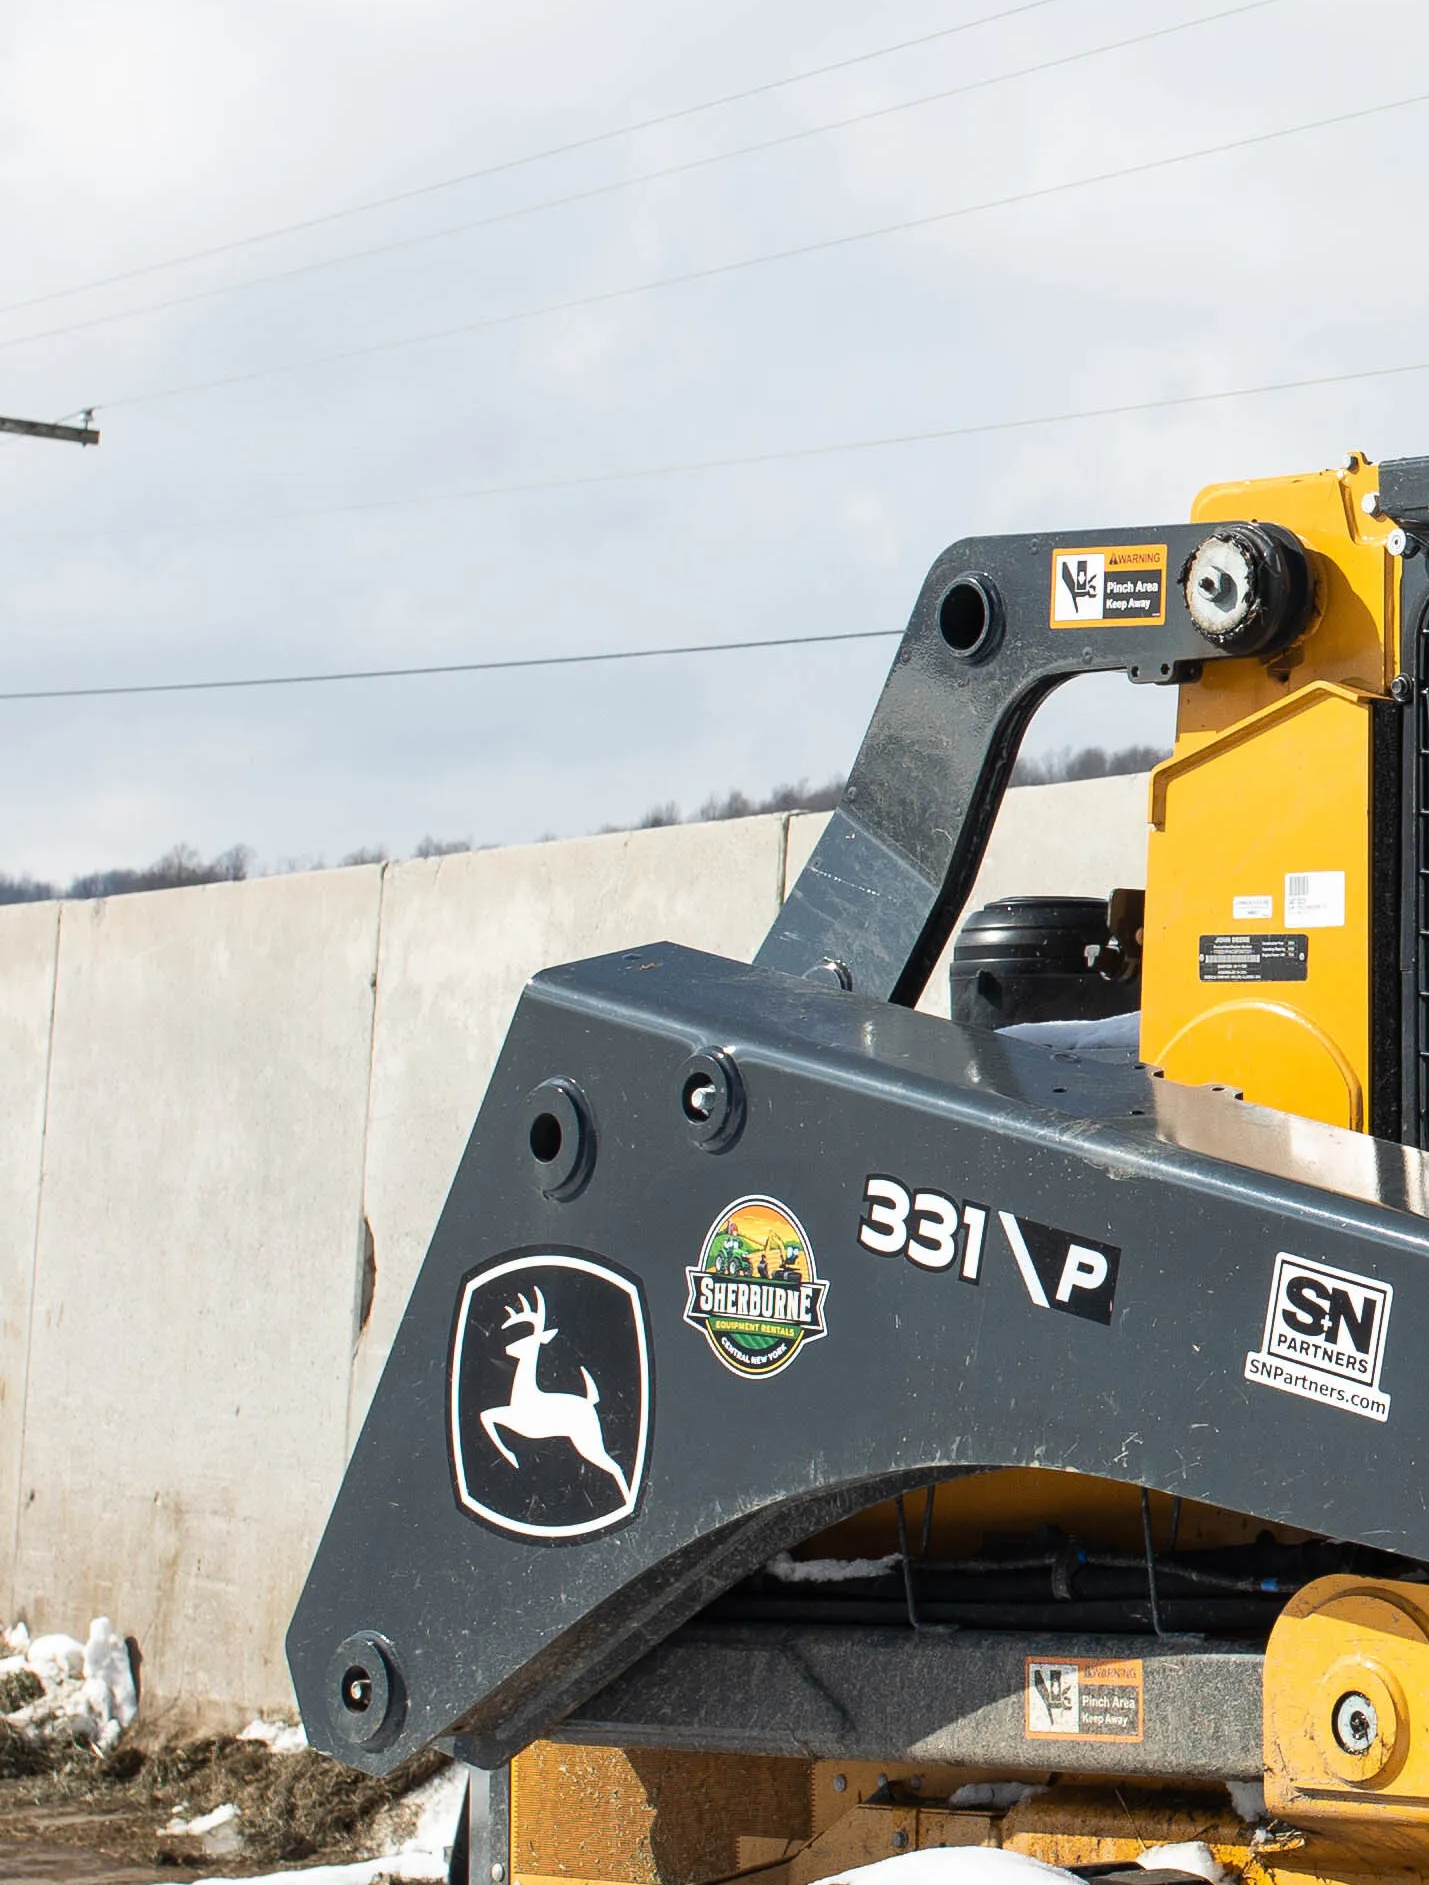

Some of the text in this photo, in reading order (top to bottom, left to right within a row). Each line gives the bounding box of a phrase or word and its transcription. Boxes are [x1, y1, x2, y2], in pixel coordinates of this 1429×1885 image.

[1118, 553, 1161, 564] WARNING
[1106, 580, 1159, 594] Pinch Area
[1105, 598, 1151, 611] Keep Away
[859, 1177, 1109, 1303] 331 P
[699, 1276, 813, 1323] SHERBURNE
[1281, 1275, 1378, 1356] SN
[714, 1320, 795, 1337] EQUIPMENT RENTALS
[720, 1336, 789, 1365] CENTRAL NEW YORK
[1276, 1332, 1370, 1375] PARTNERS
[1248, 1358, 1387, 1415] SNPartners.com
[1091, 1666, 1137, 1680] WARNING
[1082, 1694, 1136, 1710] Pinch Area
[1082, 1711, 1129, 1728] Keep Away
